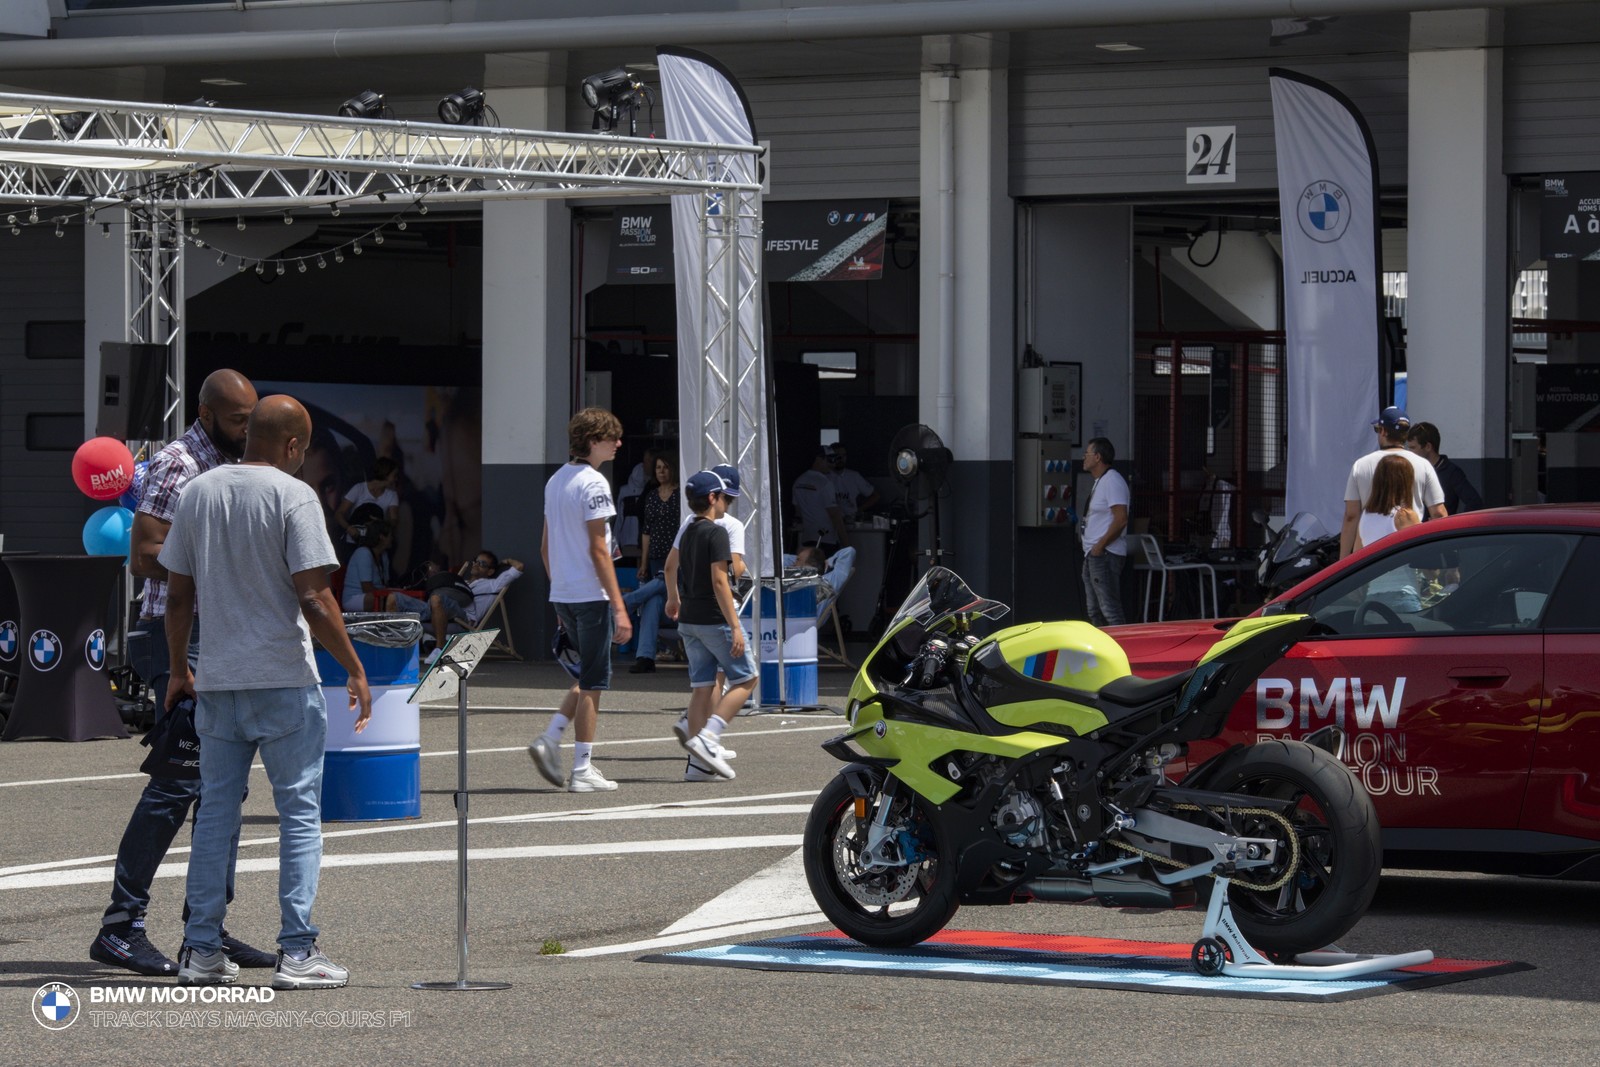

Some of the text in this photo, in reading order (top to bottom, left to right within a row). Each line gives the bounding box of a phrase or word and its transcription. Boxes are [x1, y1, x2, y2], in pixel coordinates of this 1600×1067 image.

[1187, 133, 1235, 176] 24
[1545, 179, 1564, 187] BMW
[621, 216, 652, 229] BMW
[1563, 214, 1600, 233] A à
[620, 228, 651, 236] PASSION
[636, 234, 657, 242] TOUR
[765, 239, 819, 251] IFESTYLE
[630, 266, 651, 274] 50
[1547, 394, 1598, 402] MOTORRAD
[90, 464, 124, 486] BMW
[32, 631, 58, 644] BMW
[1054, 648, 1098, 680] M
[1256, 677, 1407, 730] BMW
[178, 739, 201, 753] WE A
[1221, 918, 1234, 934] BMW
